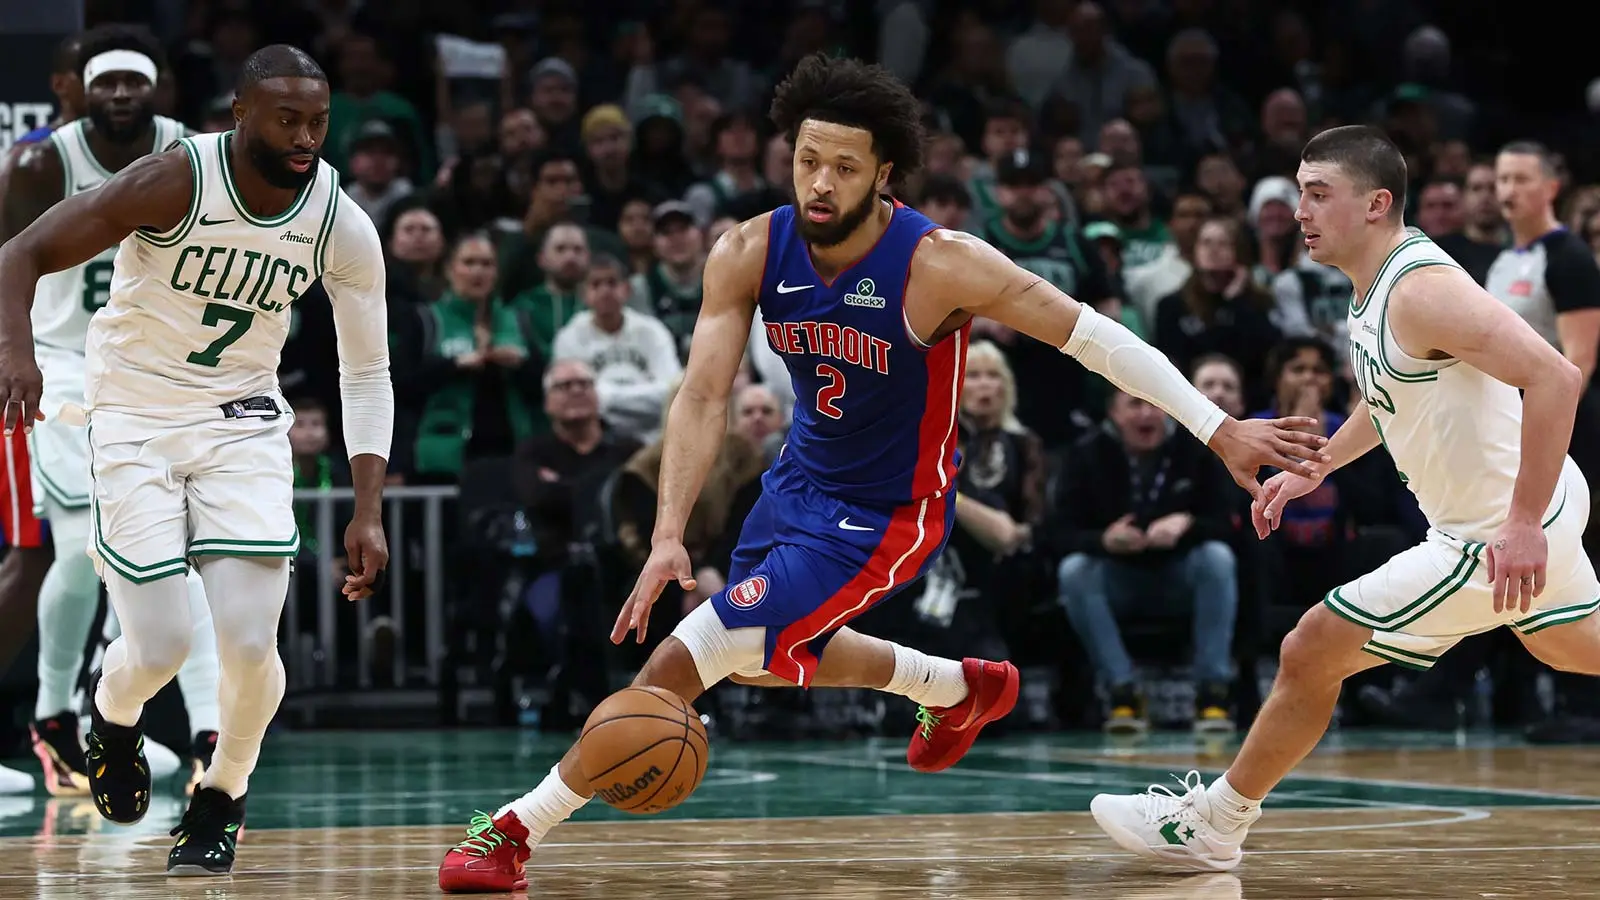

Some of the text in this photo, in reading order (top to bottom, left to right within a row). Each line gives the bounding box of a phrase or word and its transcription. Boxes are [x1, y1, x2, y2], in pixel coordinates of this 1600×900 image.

[279, 230, 314, 244] Amica
[170, 245, 308, 313] CELTICS
[845, 295, 884, 307] StockX
[186, 302, 255, 367] 7
[764, 321, 892, 375] DETROIT
[816, 363, 846, 420] 2
[595, 765, 664, 804] Wilson
